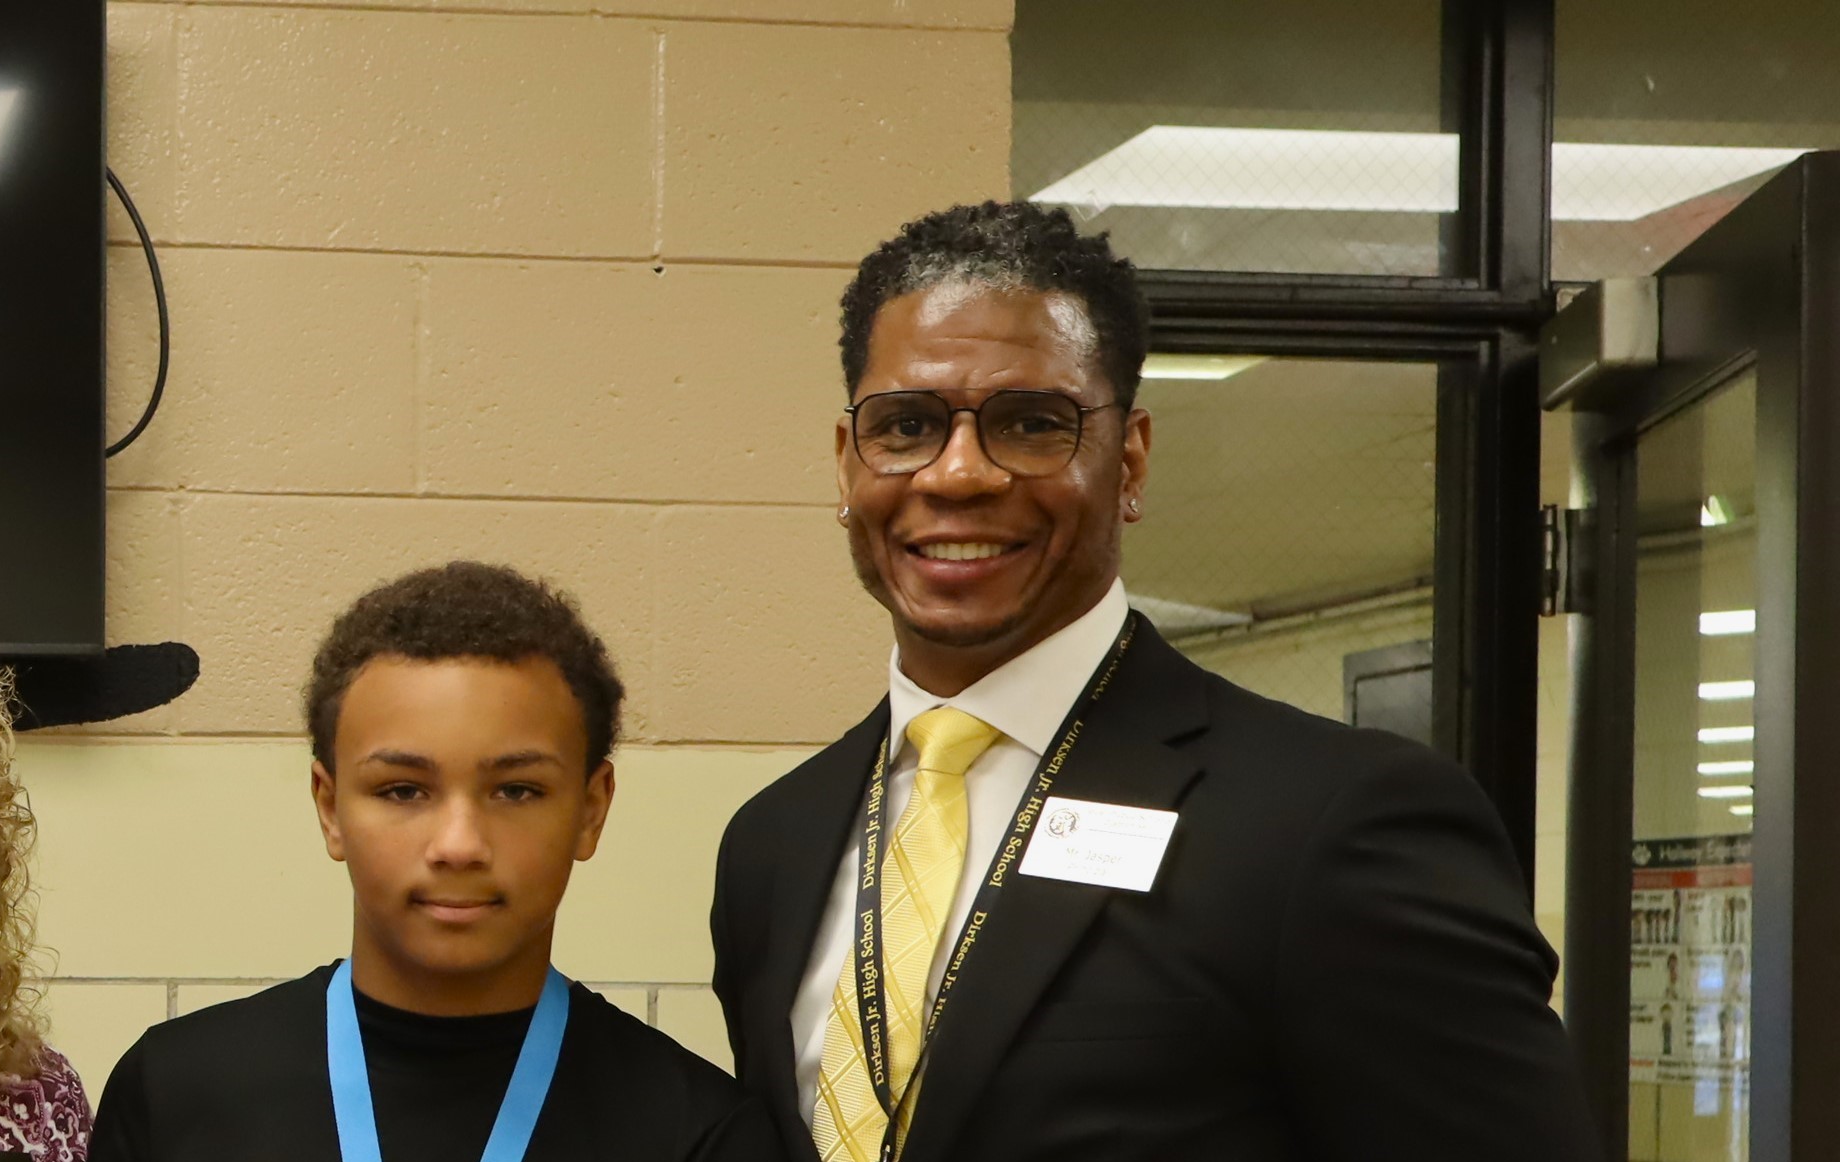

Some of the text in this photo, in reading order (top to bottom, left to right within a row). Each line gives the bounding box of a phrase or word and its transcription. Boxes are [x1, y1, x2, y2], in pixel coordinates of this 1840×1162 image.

[868, 780, 884, 815] High
[1014, 796, 1043, 834] High
[866, 815, 881, 834] Jr.
[863, 833, 879, 890] Dirksen
[988, 835, 1023, 888] School
[950, 910, 988, 971] Dirksen
[860, 908, 885, 1087] Dirksen Jr. High School
